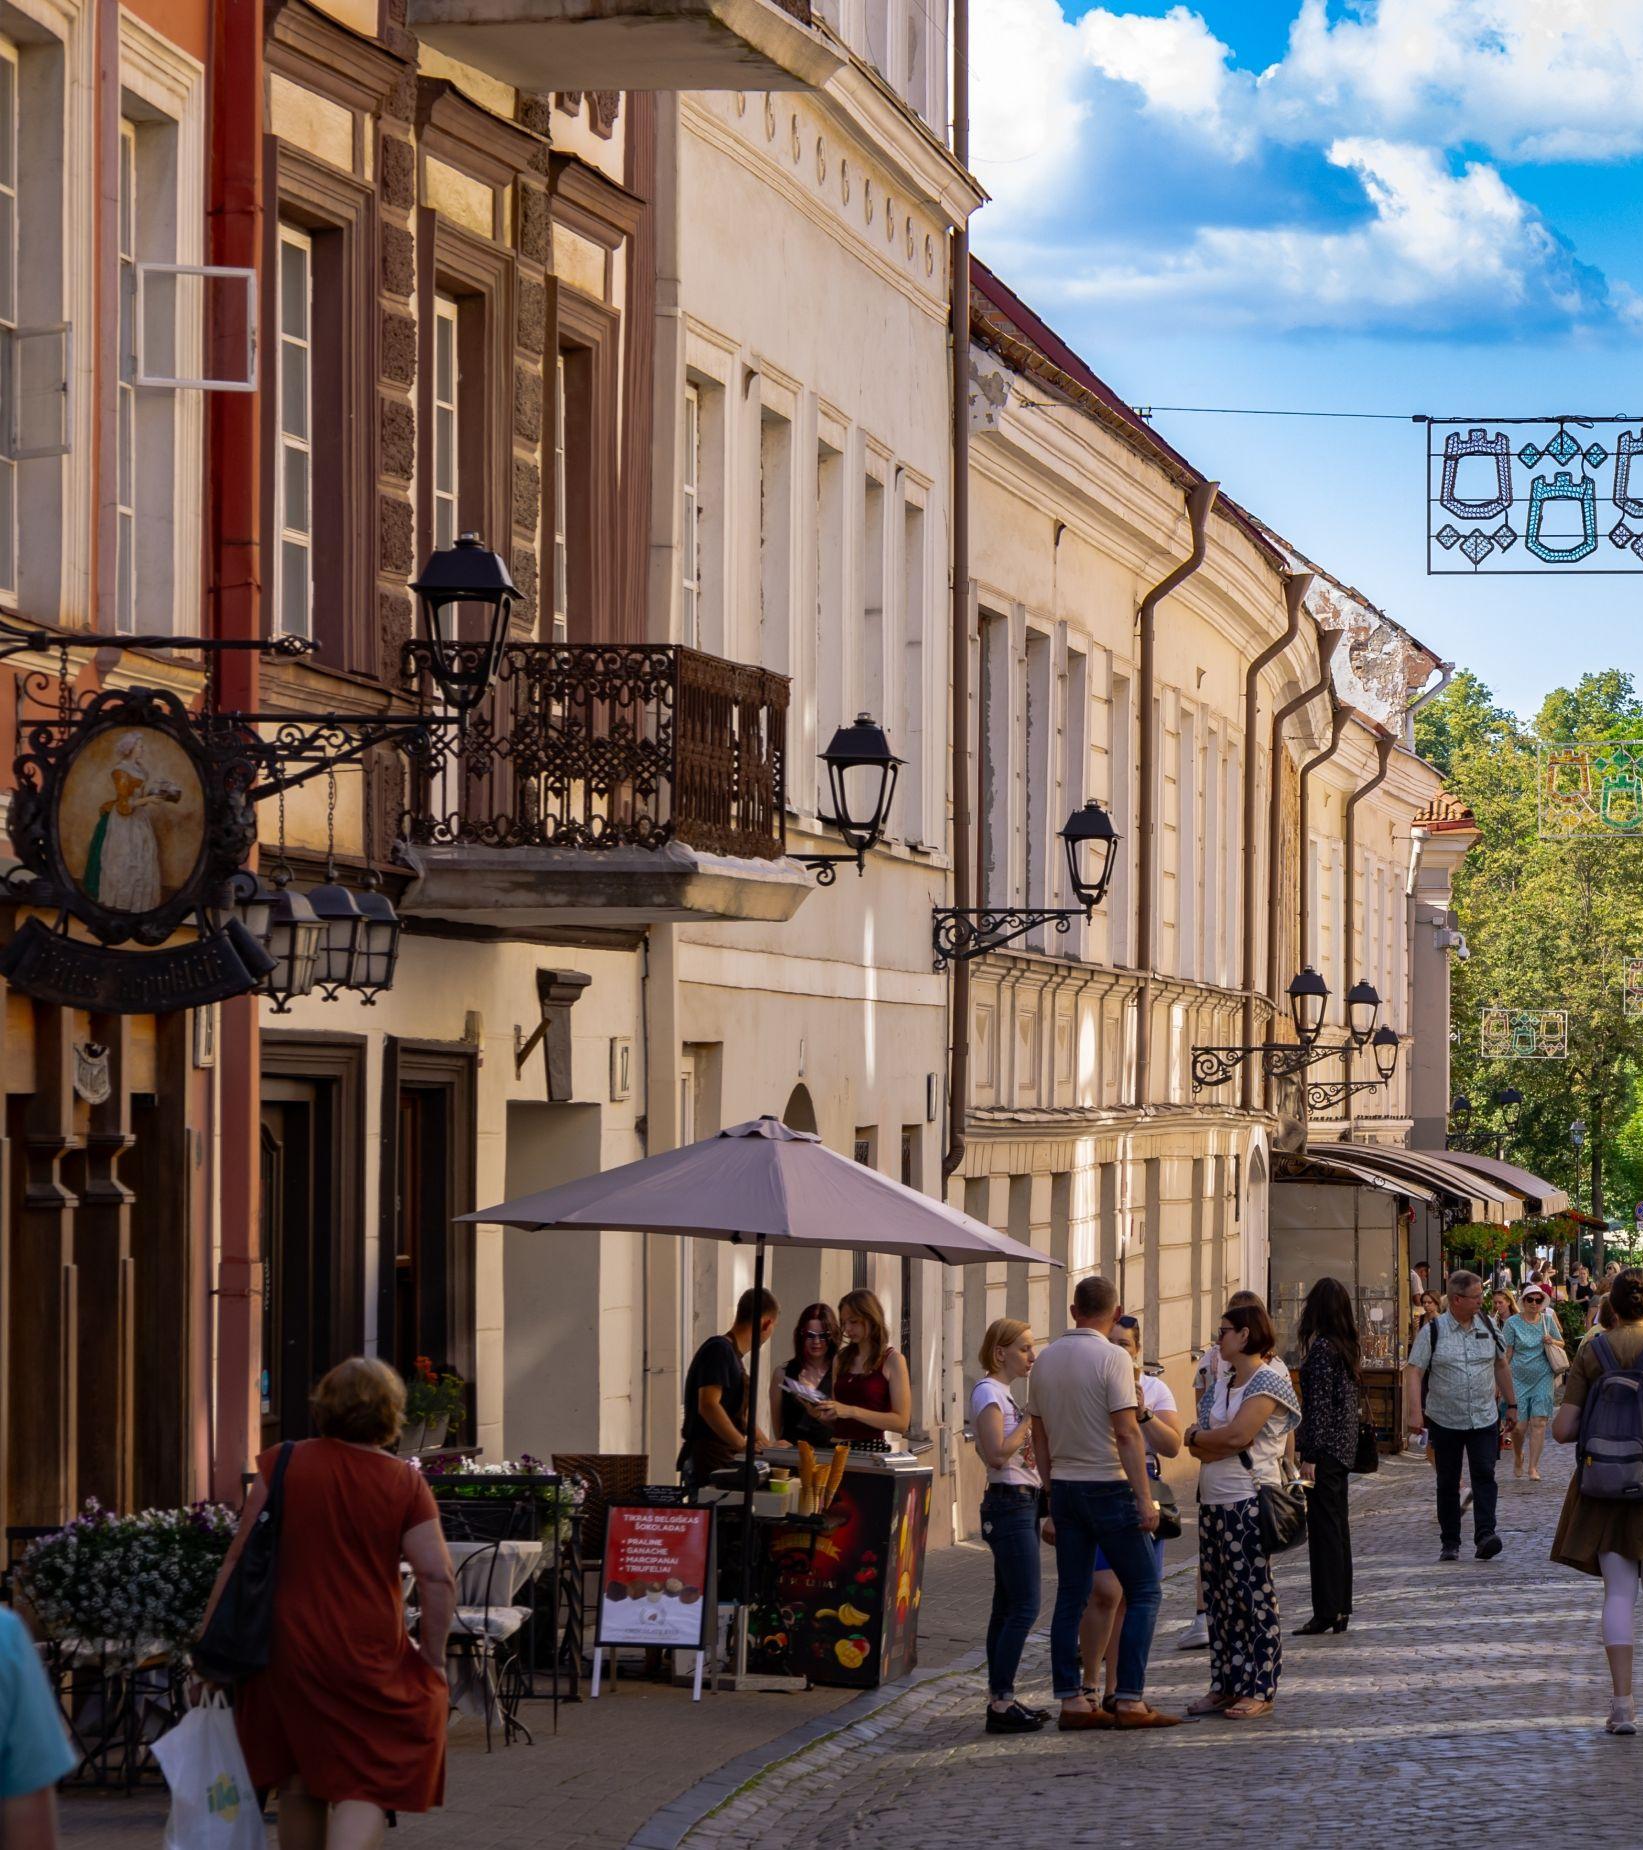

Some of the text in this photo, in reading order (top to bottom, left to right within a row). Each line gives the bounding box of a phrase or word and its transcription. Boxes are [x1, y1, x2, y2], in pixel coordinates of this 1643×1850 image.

[624, 1514, 699, 1524] TIKRAS BELGIŠKAS
[635, 1521, 686, 1532] ŠOKOLADAS
[627, 1538, 664, 1546] PRALINE
[626, 1547, 669, 1555] GANACHE
[625, 1556, 679, 1565] MARCIPANAI
[625, 1565, 672, 1573] TRIUFELIAI
[206, 1775, 239, 1813] iki
